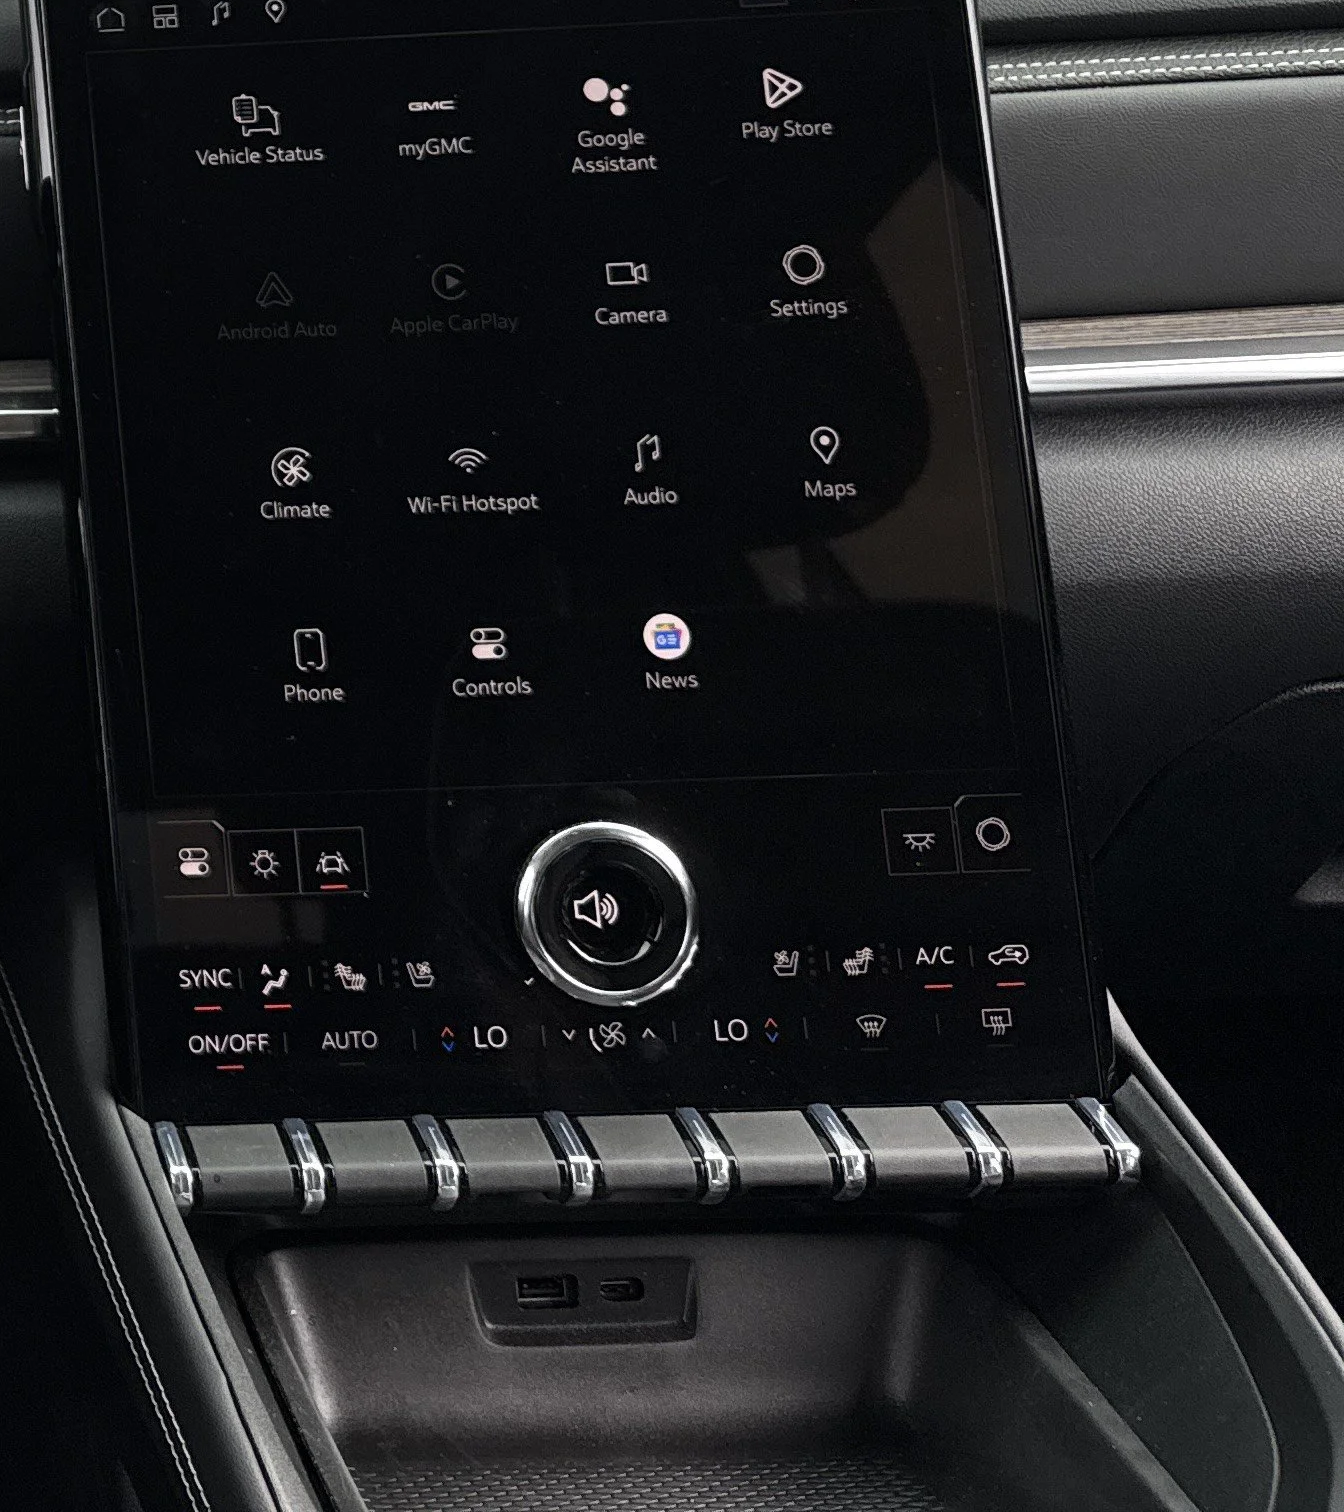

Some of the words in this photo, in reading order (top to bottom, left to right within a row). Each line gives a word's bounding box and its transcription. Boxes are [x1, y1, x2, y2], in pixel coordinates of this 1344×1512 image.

[408, 101, 454, 111] GMC
[577, 128, 646, 152] Google
[741, 120, 776, 143] Play
[782, 119, 833, 136] Store
[196, 147, 260, 165] Vehicle
[266, 146, 323, 162] Status
[399, 137, 471, 160] myGMC
[572, 155, 657, 173] Assistant
[595, 308, 667, 324] Camera
[770, 299, 847, 318] Settings
[218, 321, 289, 339] Android
[294, 322, 337, 337] Auto
[390, 316, 443, 338] Apple
[448, 312, 519, 335] CarPlay
[624, 486, 677, 504] Audio
[805, 480, 856, 500] Maps
[261, 501, 330, 518] Climate
[407, 495, 456, 513] Wi-Fi
[462, 494, 538, 514] Hotspot
[453, 676, 532, 696] Controls
[646, 672, 698, 688] News
[284, 684, 343, 701] Phone
[916, 946, 954, 964] A/C
[179, 969, 231, 987] SYNC
[474, 1026, 507, 1048] LO
[714, 1019, 747, 1041] LO
[189, 1034, 268, 1053] ON/OFF
[322, 1031, 377, 1049] AUTO
